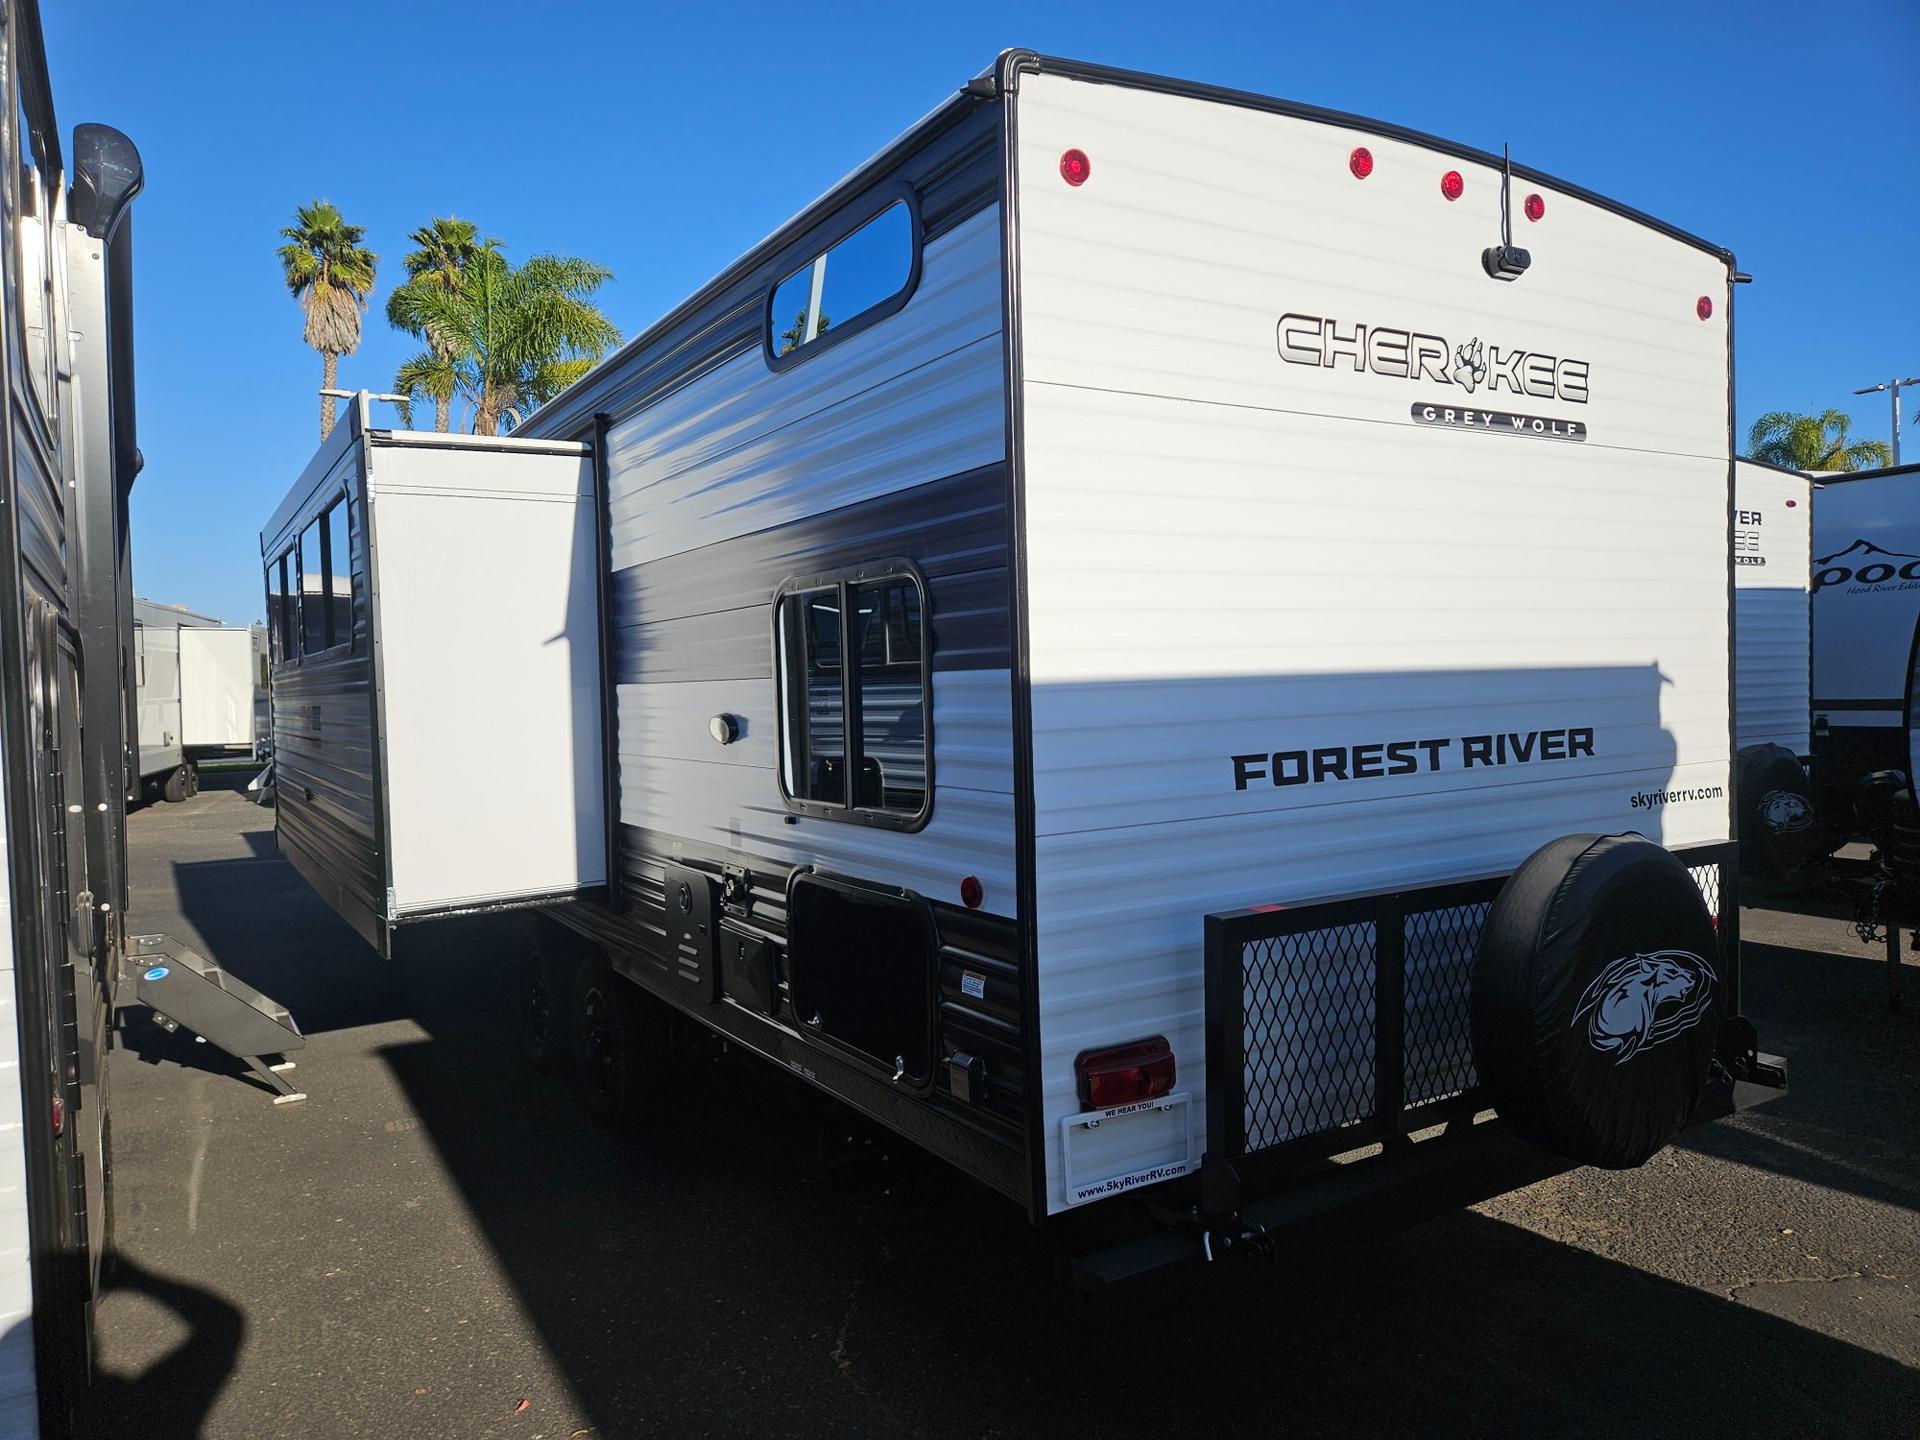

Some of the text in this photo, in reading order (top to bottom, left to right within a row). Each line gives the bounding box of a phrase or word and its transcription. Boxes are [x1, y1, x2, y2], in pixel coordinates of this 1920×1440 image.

[1422, 406, 1577, 438] GREY WOLF
[1873, 583, 1897, 593] River
[1229, 726, 1595, 790] FOREST RIVER
[1630, 786, 1723, 810] skyriverrv.com
[1105, 1102, 1154, 1117] WE HEAR YOU!
[1077, 1164, 1186, 1199] www.SkyRiverRV.com
